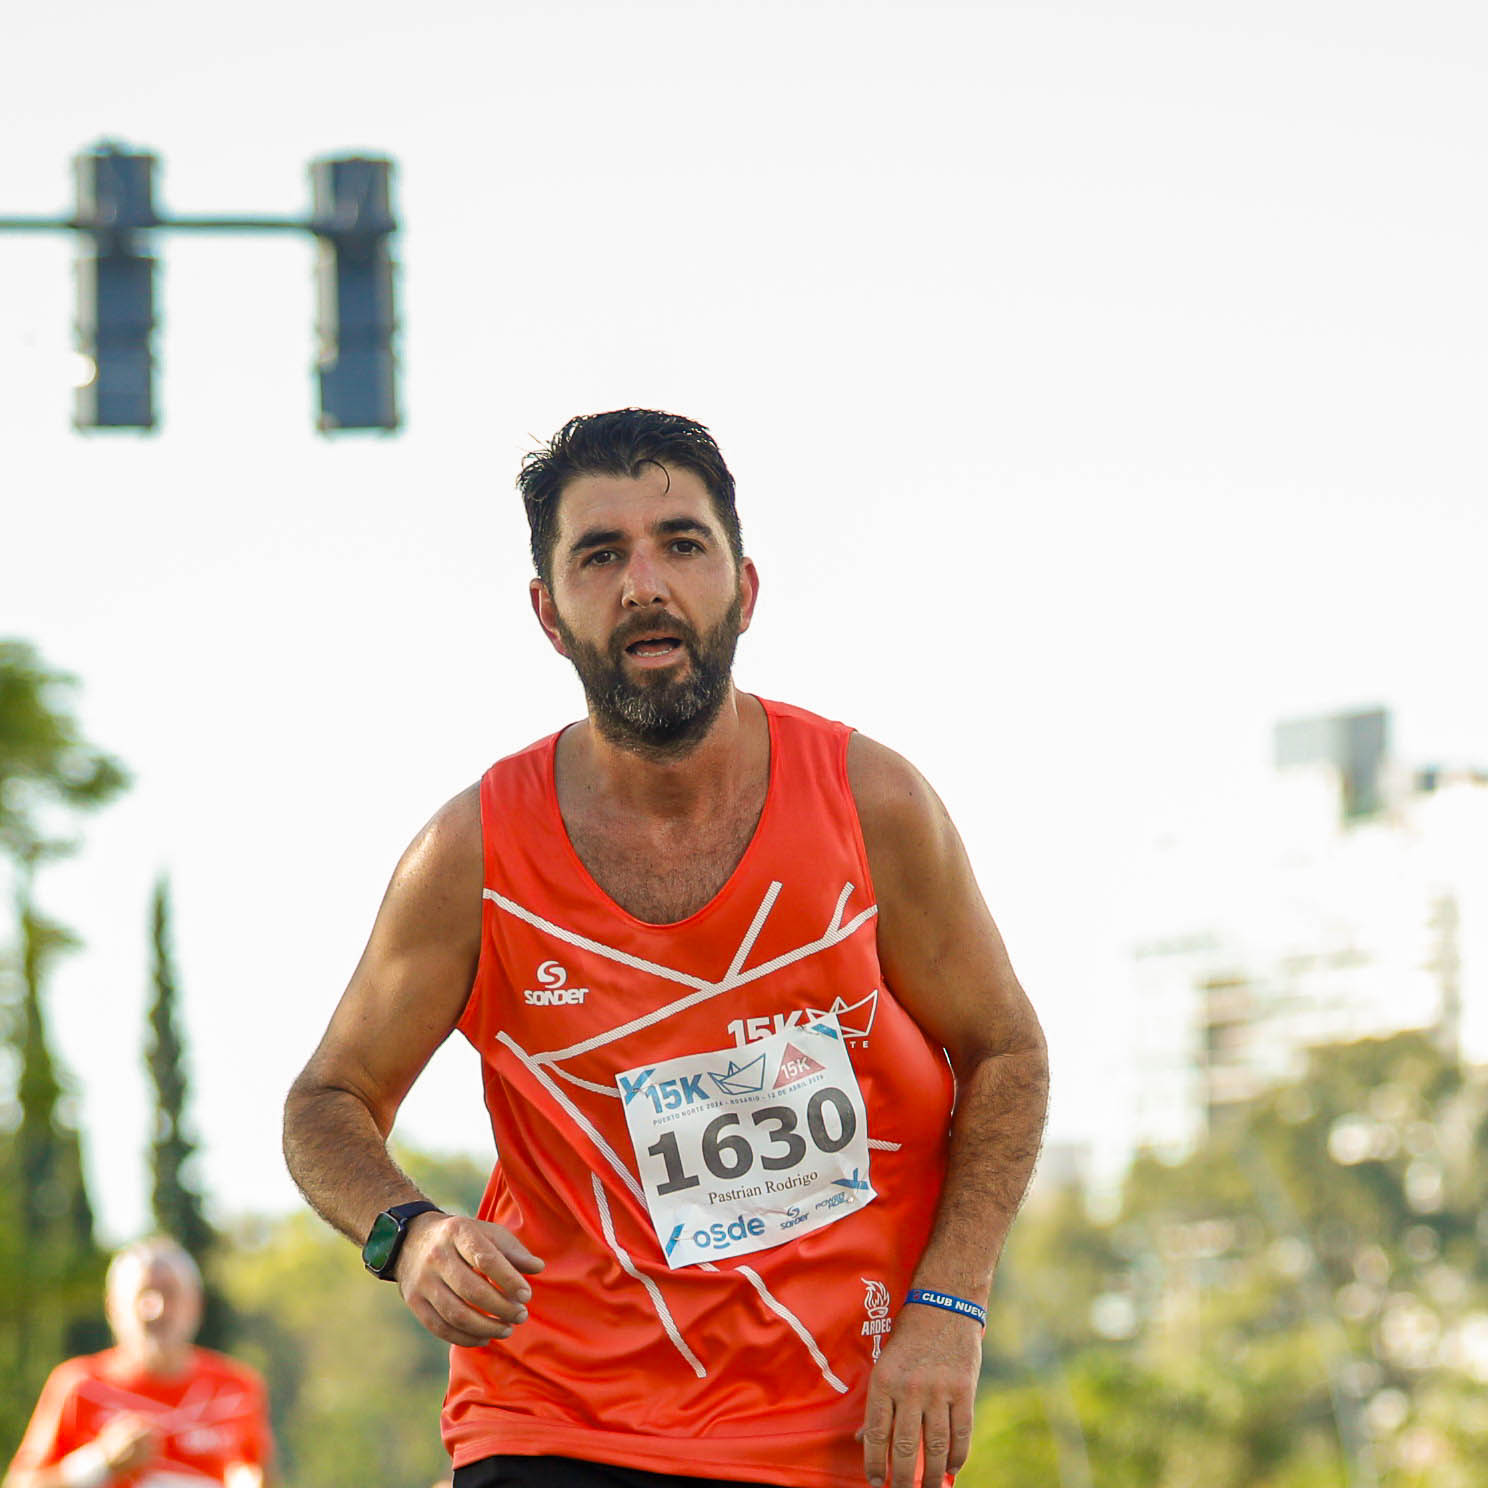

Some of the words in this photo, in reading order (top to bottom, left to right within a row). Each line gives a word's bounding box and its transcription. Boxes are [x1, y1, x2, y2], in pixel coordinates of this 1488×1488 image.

[781, 1056, 811, 1080] 15K
[647, 1073, 710, 1114] 15K
[653, 1113, 680, 1125] PUERTO
[682, 1105, 704, 1117] NORTE
[730, 1095, 760, 1105] ROSARIO
[777, 1088, 787, 1097] DE
[789, 1082, 807, 1092] ABRIL
[647, 1087, 856, 1196] 1630
[708, 1184, 762, 1205] Pastrian
[765, 1171, 818, 1194] Rodrigo
[693, 1215, 765, 1249] osde
[922, 1292, 952, 1307] CLUB
[861, 1318, 892, 1336] ARDEC
